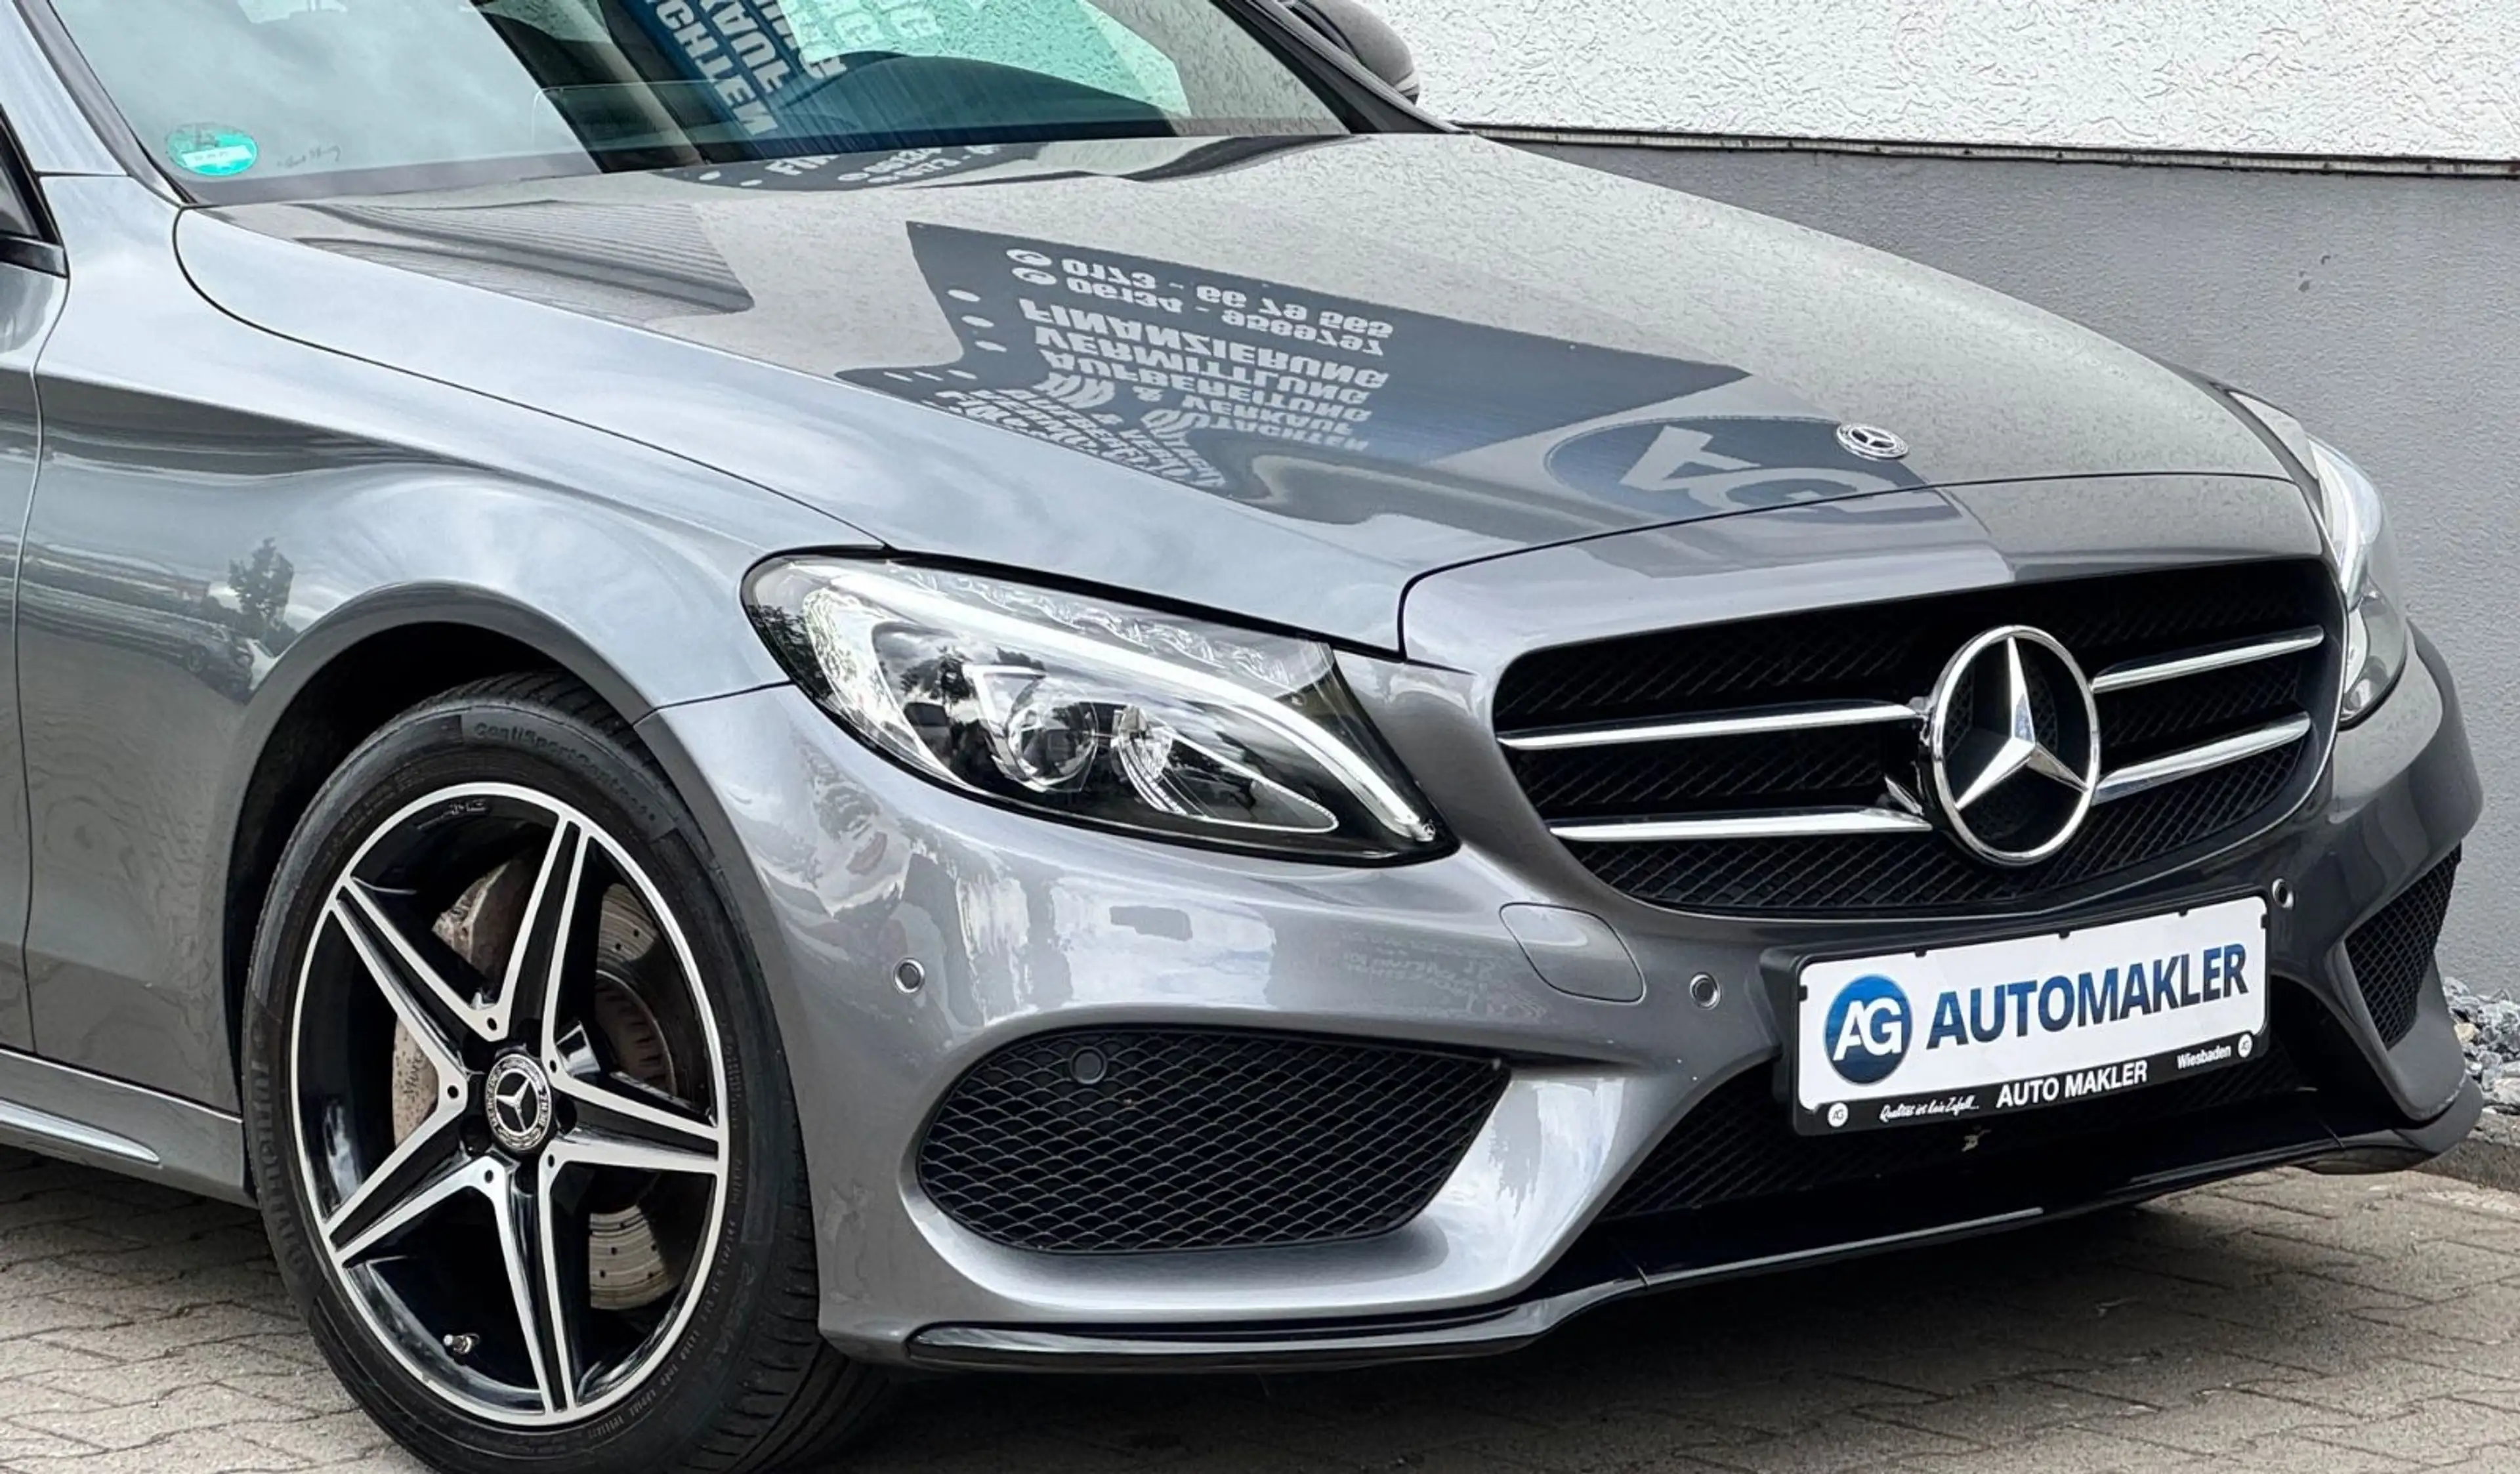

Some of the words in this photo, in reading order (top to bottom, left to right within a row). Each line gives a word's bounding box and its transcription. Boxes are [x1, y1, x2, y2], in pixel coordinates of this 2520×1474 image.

[1926, 943, 2247, 1049] AUTOMAKLER
[1833, 999, 1902, 1061] AG
[2177, 1044, 2231, 1070] Wiesbaden
[1996, 1077, 2059, 1109] AUTO
[2064, 1059, 2148, 1099] MAKLER
